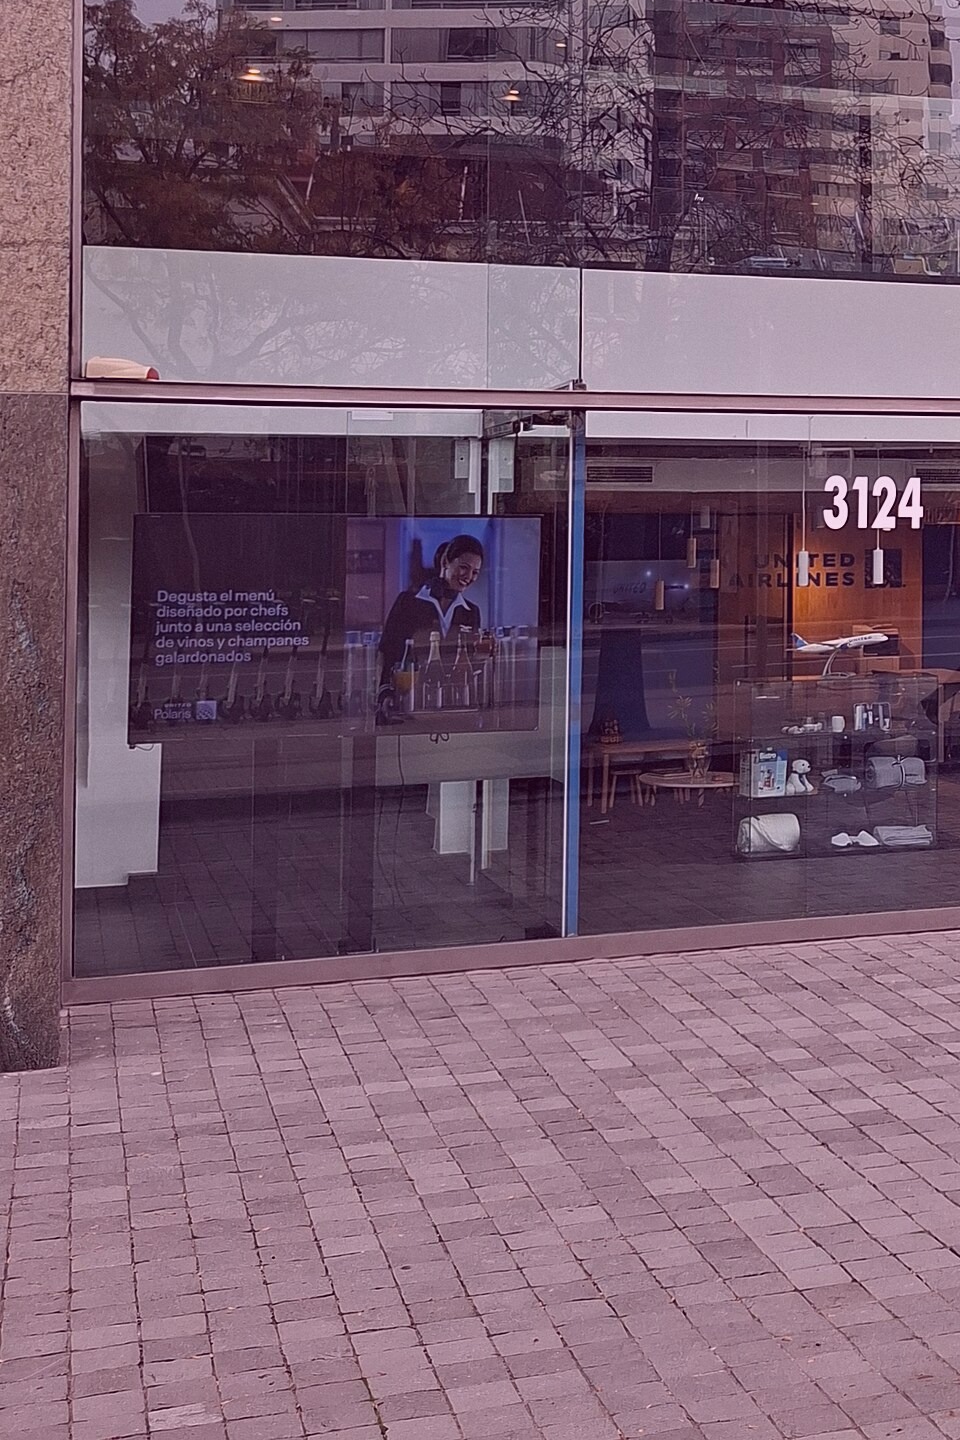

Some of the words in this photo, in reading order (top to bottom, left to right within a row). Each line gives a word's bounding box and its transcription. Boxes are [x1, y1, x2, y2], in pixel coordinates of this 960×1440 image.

[823, 475, 924, 530] 3124
[754, 553, 855, 568] UNITED
[728, 572, 855, 588] AIRLINES
[157, 590, 217, 604] Degusta
[220, 590, 232, 602] el
[235, 589, 275, 602] menú
[156, 604, 222, 618] diseñado
[224, 607, 248, 619] por
[250, 604, 289, 617] chefs
[155, 621, 192, 636] junto
[194, 624, 203, 633] a
[206, 623, 232, 633] una
[235, 619, 301, 632] selección
[156, 636, 175, 649] de
[177, 636, 214, 648] vinos
[217, 637, 226, 650] y
[227, 634, 310, 648] champanes
[156, 650, 251, 666] galardonados
[154, 708, 192, 720] Polaris
